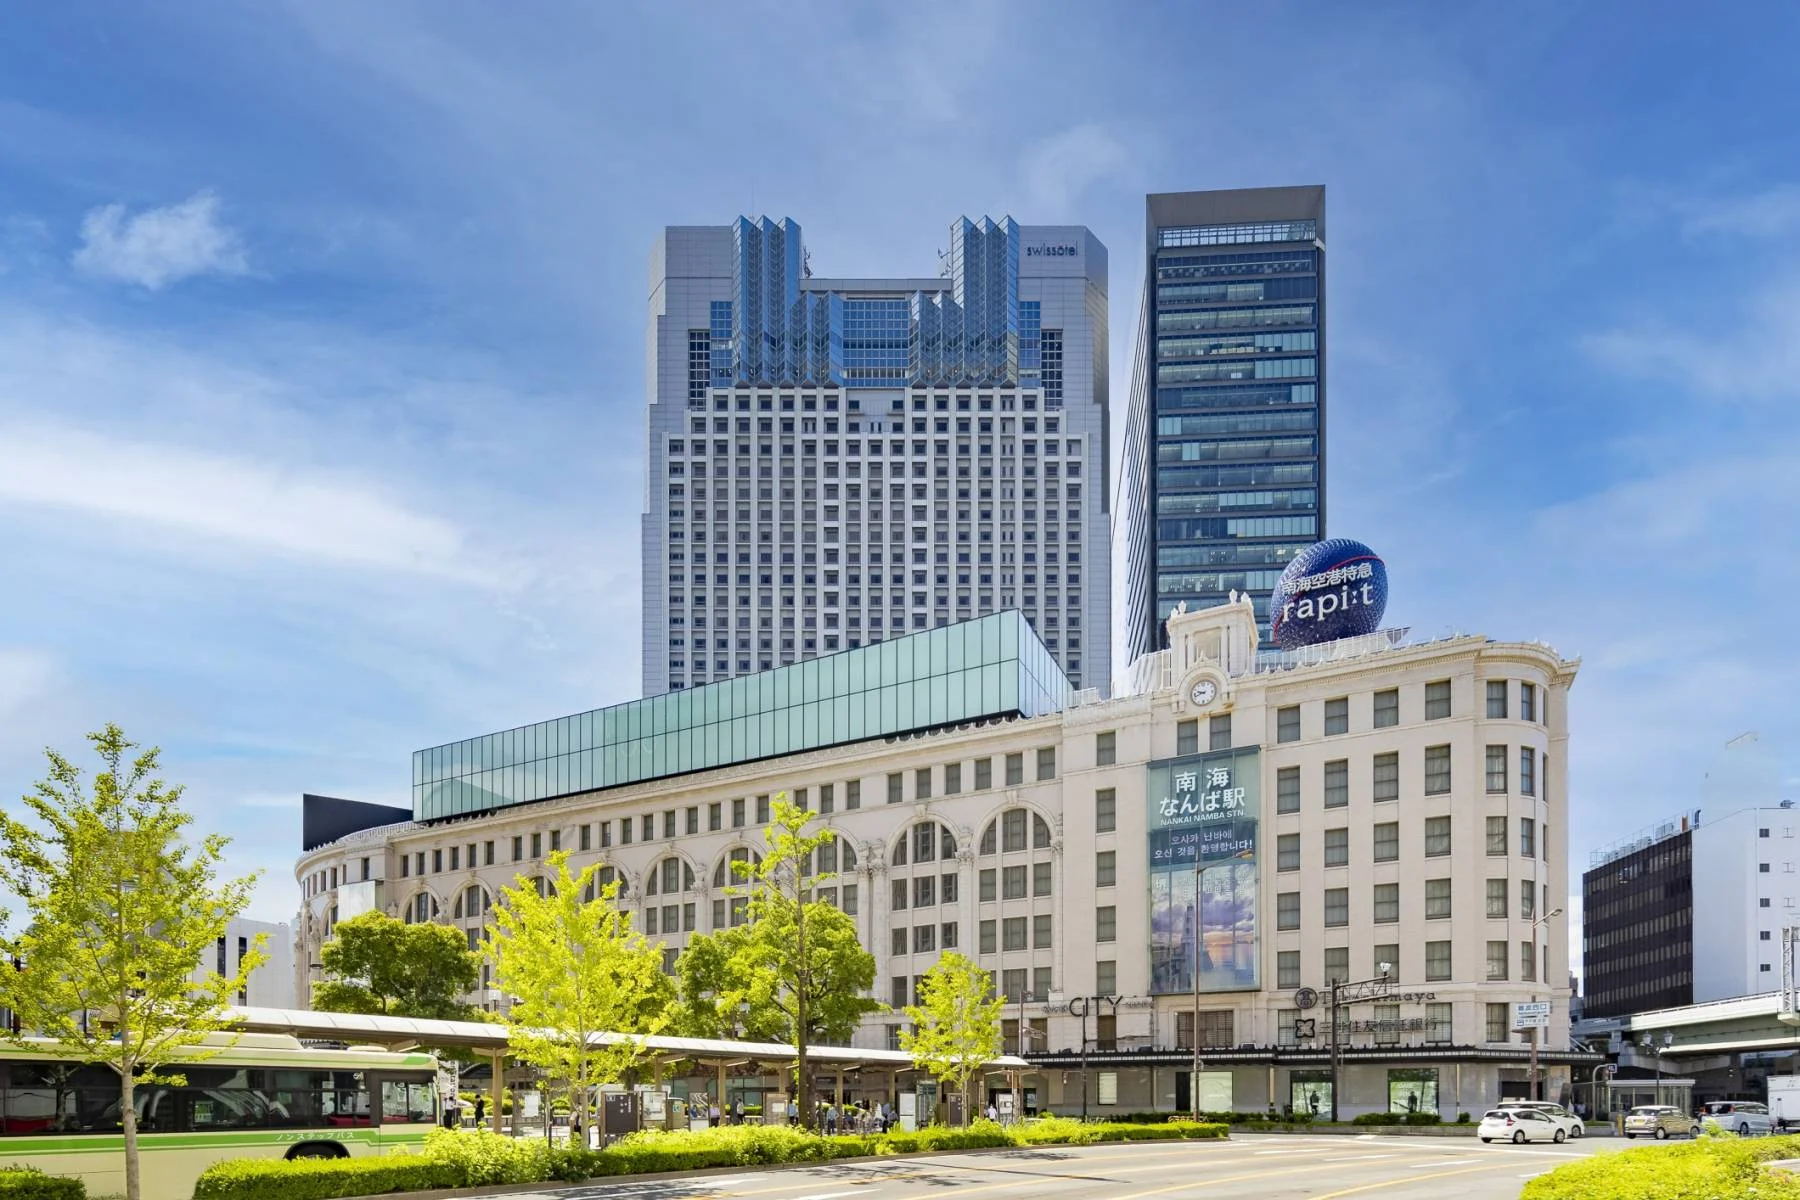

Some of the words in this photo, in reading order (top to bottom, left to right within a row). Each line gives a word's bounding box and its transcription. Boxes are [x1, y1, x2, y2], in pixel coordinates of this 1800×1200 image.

[1282, 562, 1373, 594] 南海空港特急
[1160, 787, 1245, 817] なんば駅
[1161, 815, 1192, 826] NANKAI
[1194, 812, 1225, 822] NAMBA
[1171, 833, 1198, 845] 오사카
[1319, 988, 1437, 1005] Tkamaya
[1069, 996, 1124, 1017] CITY
